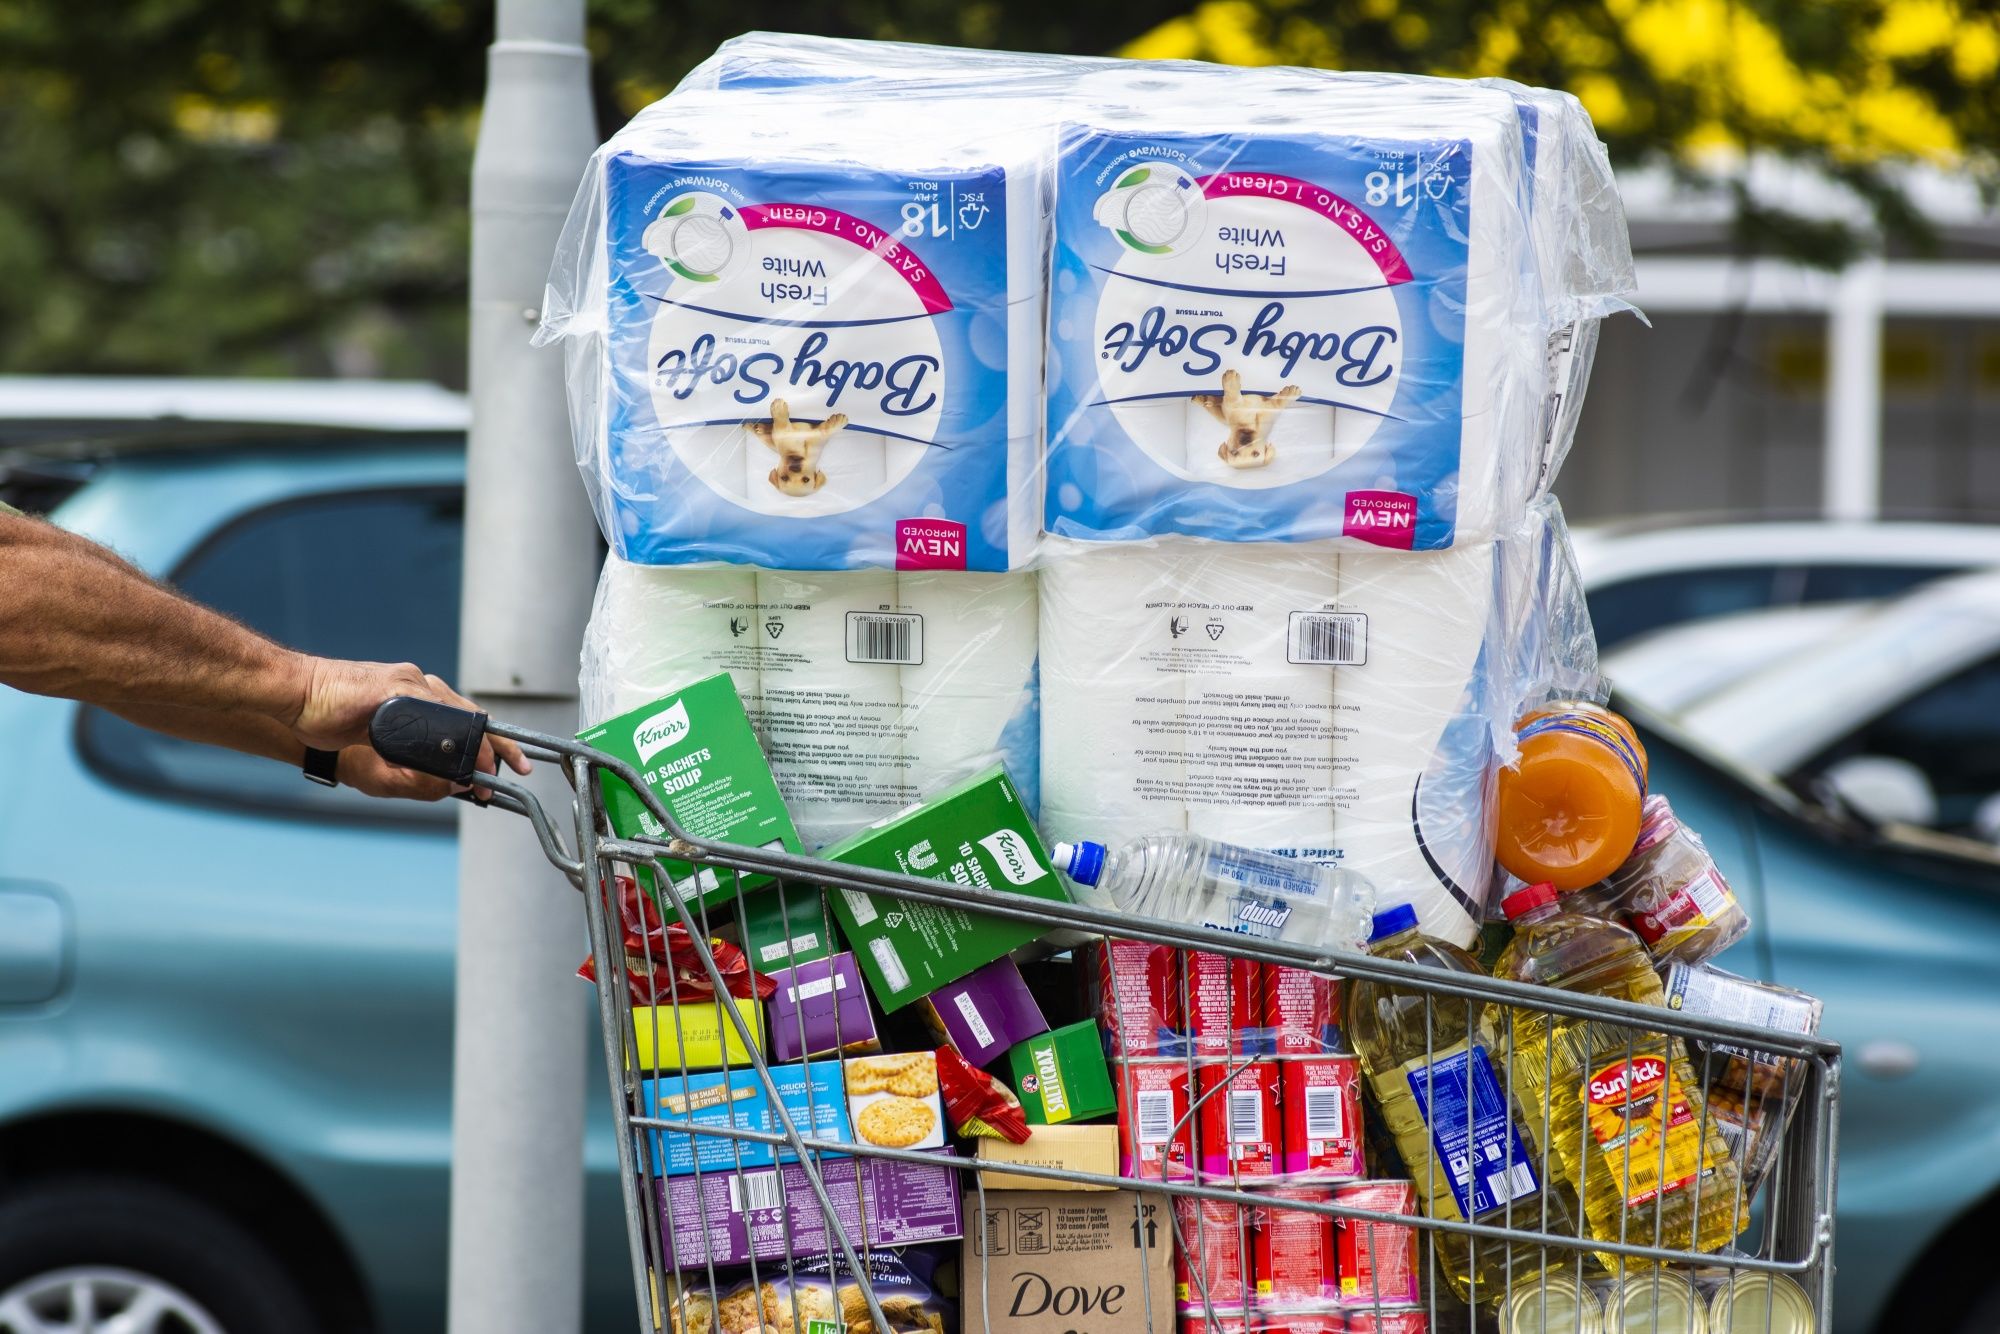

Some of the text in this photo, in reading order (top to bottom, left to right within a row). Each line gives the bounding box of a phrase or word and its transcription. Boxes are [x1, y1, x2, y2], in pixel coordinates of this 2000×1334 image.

[1129, 146, 1186, 163] SoftWave
[1374, 151, 1404, 159] ROLLS
[1095, 153, 1128, 187] technology
[1379, 162, 1396, 170] PLY
[1425, 162, 1450, 172] FSC
[908, 182, 938, 190] ROLLS
[1295, 184, 1303, 200] 1
[1365, 171, 1413, 208] 18
[643, 176, 745, 216] with SoftWave technology
[914, 193, 931, 201] PLY
[959, 193, 984, 202] FSC
[1313, 190, 1346, 218] No.
[834, 216, 841, 231] 1
[901, 203, 948, 238] 18
[851, 222, 883, 249] No.
[1218, 227, 1285, 248] White
[1347, 214, 1388, 253] SA'S
[762, 257, 827, 278] White
[885, 245, 926, 283] SA'S
[1215, 252, 1286, 276] Fresh
[761, 282, 828, 306] Fresh
[1175, 308, 1224, 317] TOILET TISSUE
[1104, 302, 1398, 388] Baby Soft
[657, 331, 939, 416] Baby Soft
[1352, 499, 1411, 510] IMPROVED
[1351, 510, 1410, 529] NEW
[902, 527, 960, 538] IMPROVED
[903, 540, 960, 557] NEW
[635, 720, 687, 748] Knorr
[643, 748, 711, 786] 10 SACHETS
[663, 768, 703, 795] SOUP
[957, 841, 973, 858] 10
[996, 832, 1028, 883] Knorr
[1301, 847, 1345, 860] Toilet
[1219, 867, 1244, 880] 750 ml
[1257, 875, 1316, 895] PREPARED WATER
[903, 911, 917, 932] RECYCLE
[1239, 900, 1292, 929] pump
[1286, 1036, 1310, 1047] 300 g
[779, 1080, 815, 1091] DELICIOS
[1034, 1046, 1067, 1114] SALTICRAX
[1590, 1061, 1662, 1100] SunPick
[700, 1095, 721, 1106] TRYING
[1601, 1094, 1618, 1105] PURE
[1633, 1095, 1655, 1107] REFINED
[1338, 1140, 1348, 1148] 300
[1446, 1149, 1463, 1160] STORE
[1480, 1135, 1497, 1147] DARK
[1066, 1215, 1085, 1223] layers
[1090, 1214, 1108, 1222] pallet
[1090, 1207, 1106, 1215] layer
[1133, 1204, 1157, 1218] TOP
[1091, 1222, 1110, 1230] pallet
[878, 1273, 912, 1285] crunch
[1008, 1272, 1126, 1318] Dove
